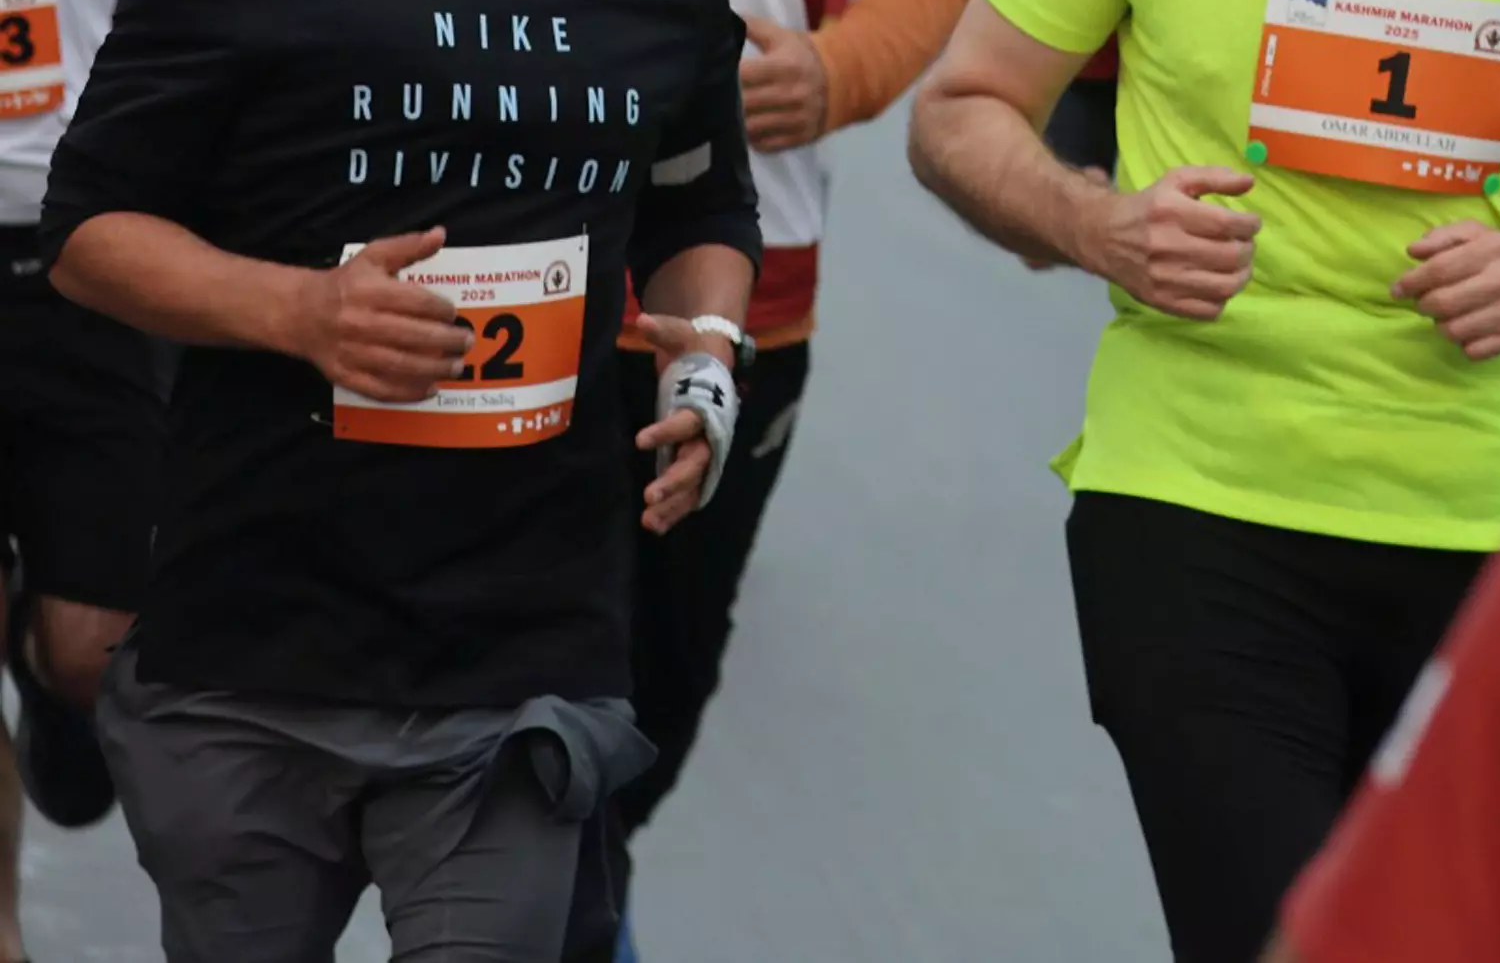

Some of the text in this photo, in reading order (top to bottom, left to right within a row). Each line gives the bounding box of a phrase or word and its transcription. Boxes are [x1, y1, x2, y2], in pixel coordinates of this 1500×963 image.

[433, 11, 571, 52] NIKE
[1334, 1, 1397, 20] KASHMIR
[1400, 10, 1474, 33] MARATHON
[1384, 24, 1419, 42] 2025
[0, 16, 34, 66] 3
[1369, 50, 1417, 119] 1
[353, 83, 640, 126] RUNNING
[1321, 119, 1369, 138] OMAR
[349, 148, 630, 194] DIVISION
[474, 270, 541, 284] MARATHON
[461, 289, 495, 302] 2025
